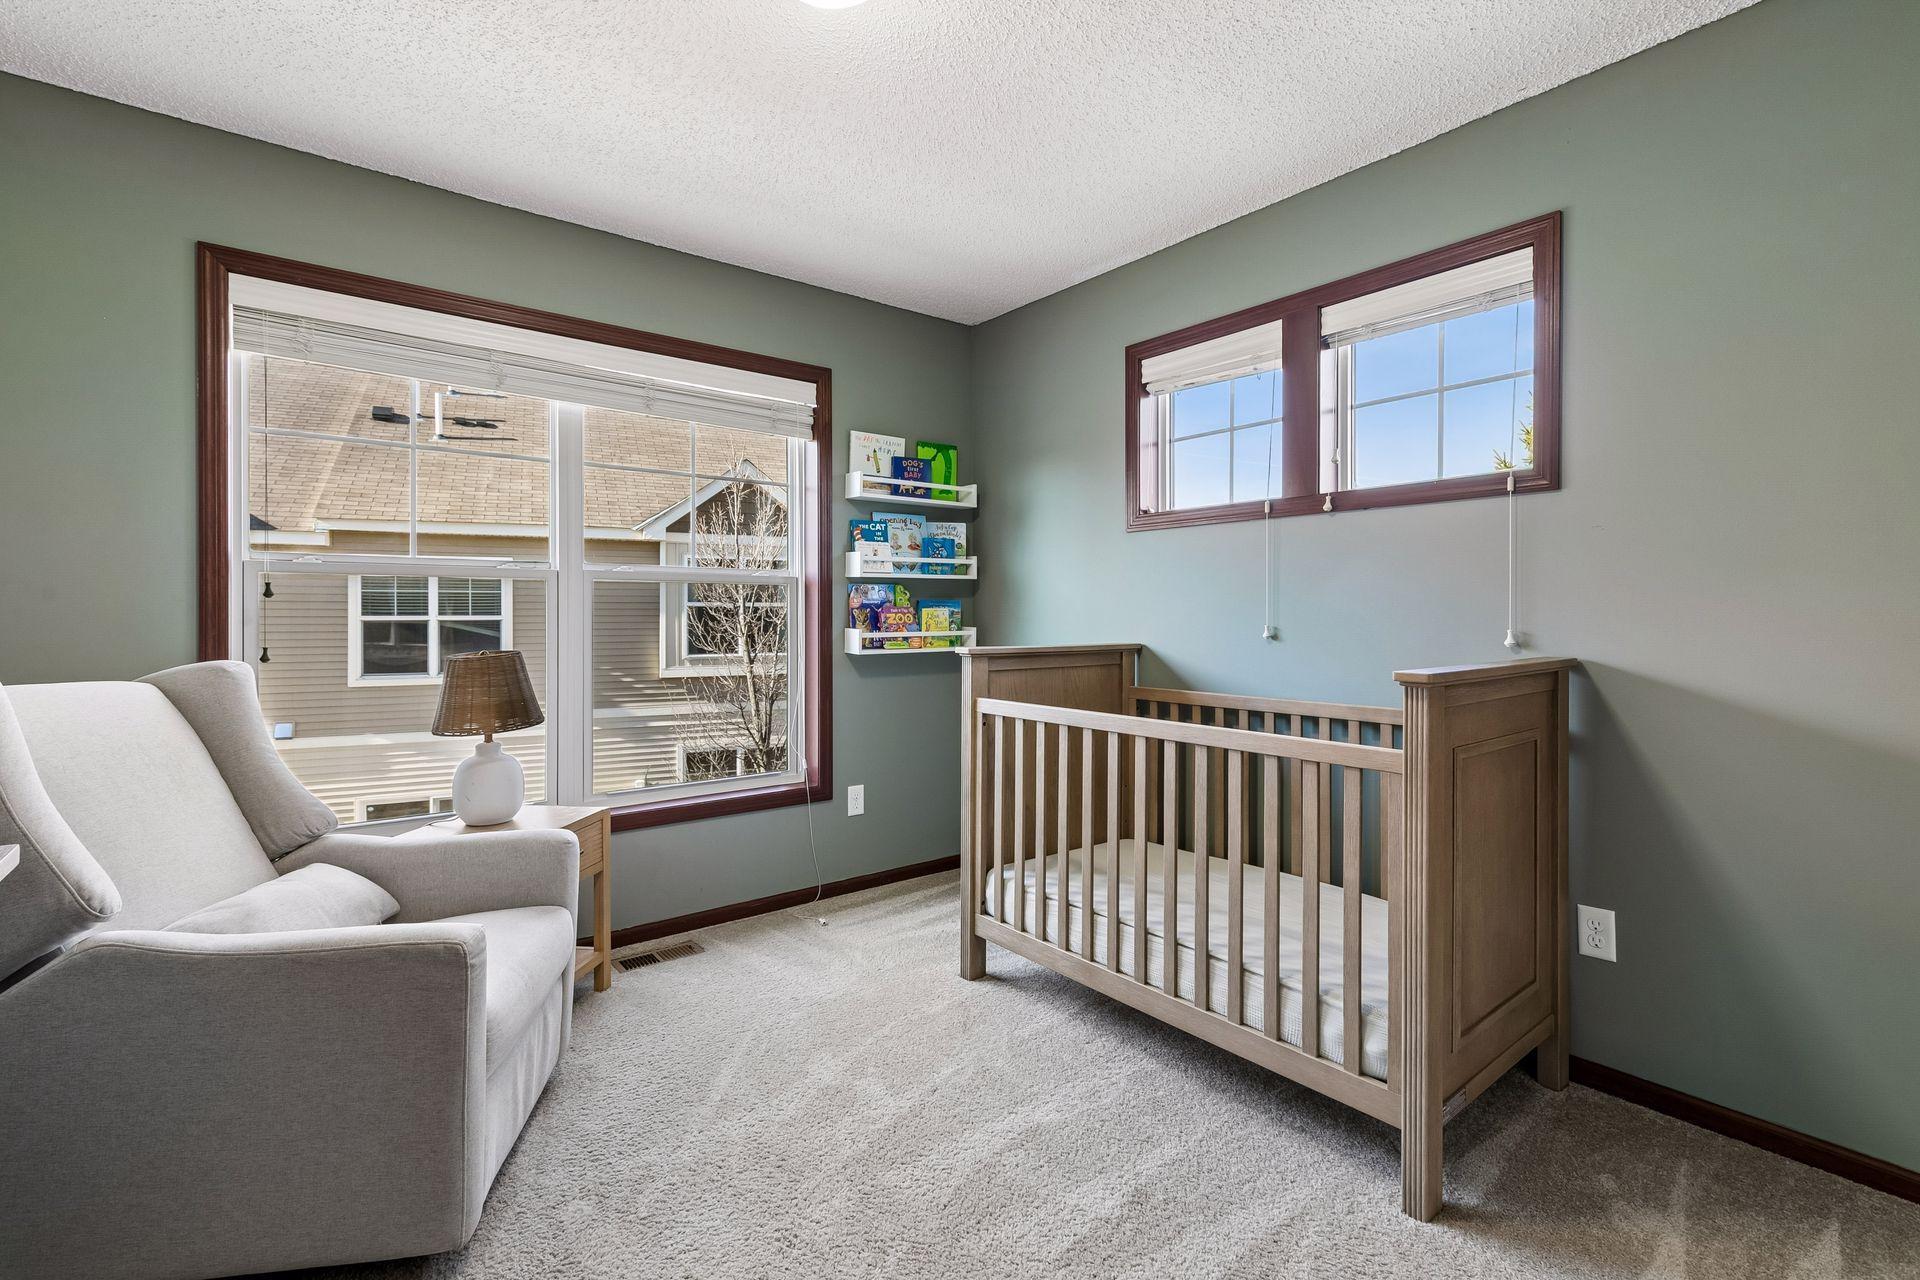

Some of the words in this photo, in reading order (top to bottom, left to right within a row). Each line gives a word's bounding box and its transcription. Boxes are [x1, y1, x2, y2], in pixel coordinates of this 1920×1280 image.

[902, 460, 924, 468] DOG'S
[869, 523, 886, 531] CAT
[886, 613, 914, 624] ZOO
